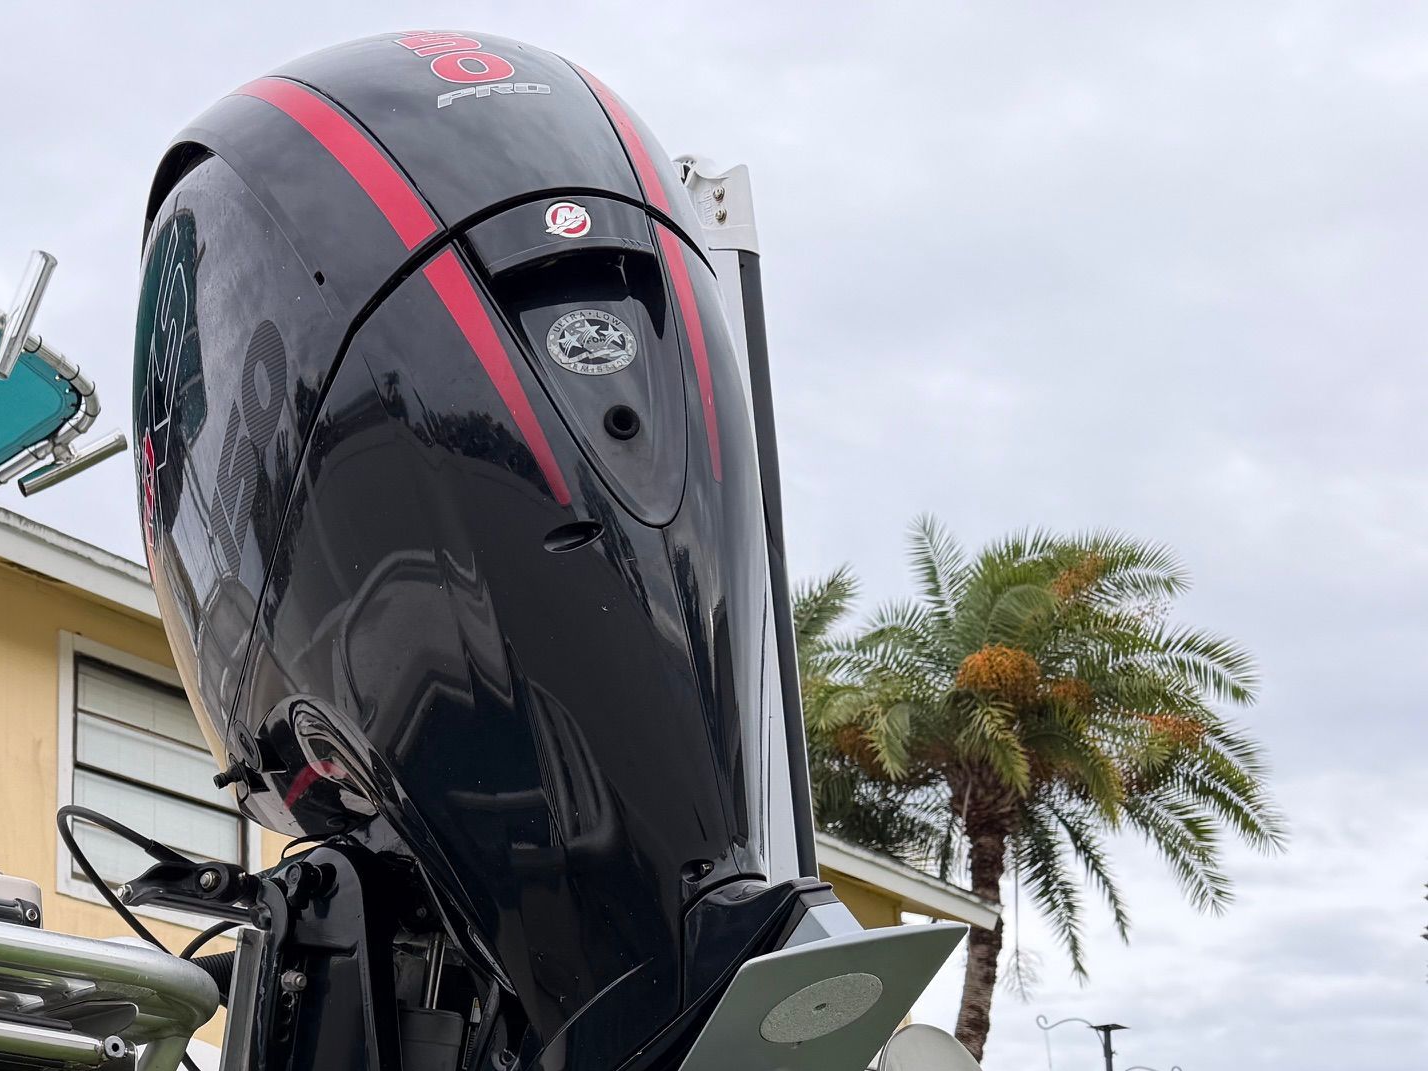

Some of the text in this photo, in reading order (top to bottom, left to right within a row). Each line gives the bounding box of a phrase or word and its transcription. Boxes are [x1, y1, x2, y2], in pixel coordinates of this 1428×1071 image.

[437, 82, 551, 109] PRO
[553, 311, 622, 333] ULTRA LOW
[210, 318, 287, 582] 150
